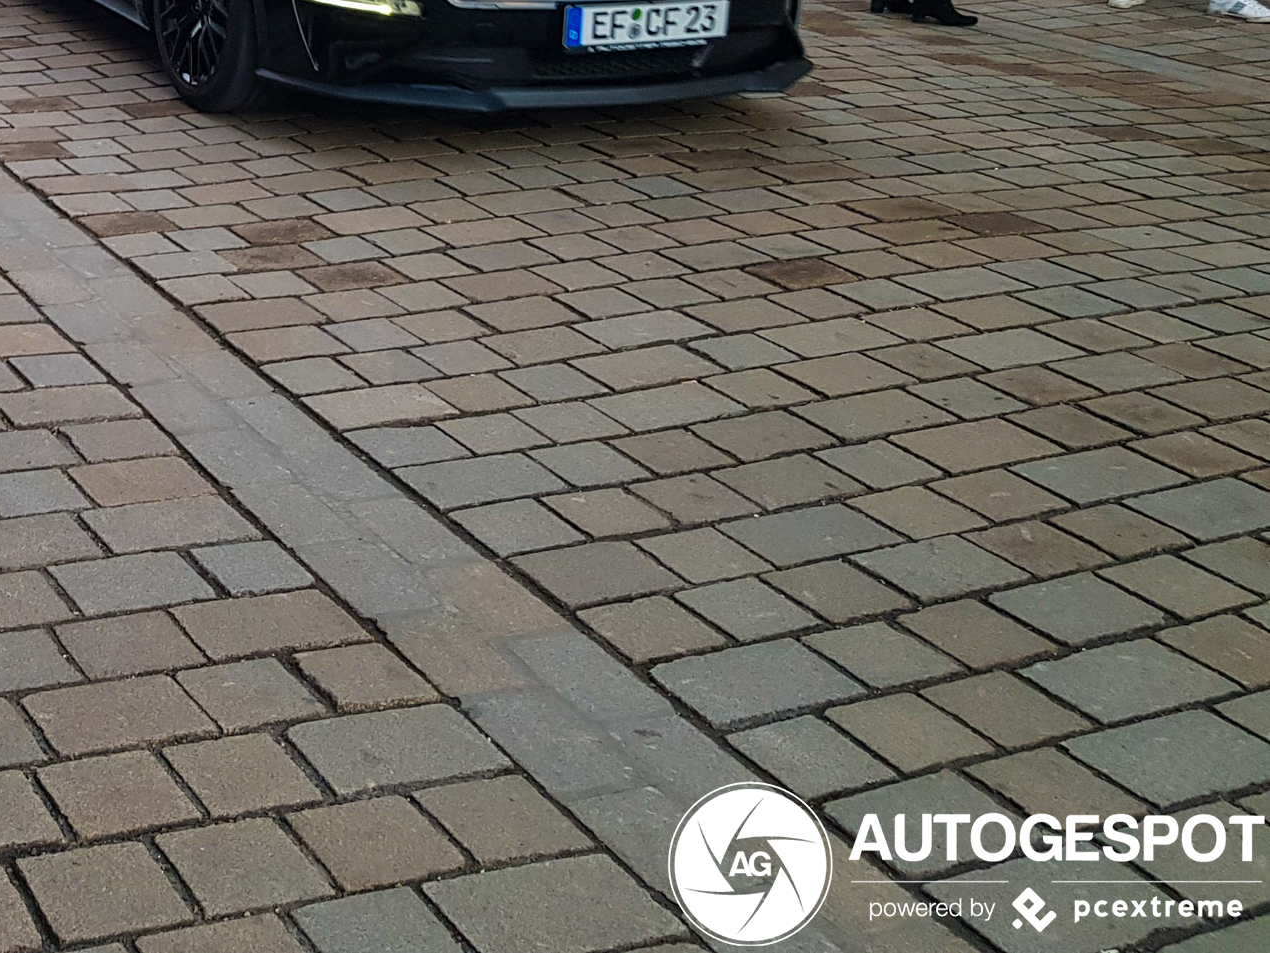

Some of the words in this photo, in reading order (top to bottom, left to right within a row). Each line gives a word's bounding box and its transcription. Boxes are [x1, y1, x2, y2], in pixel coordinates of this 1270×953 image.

[592, 11, 628, 39] EF
[646, 7, 681, 36] CF
[684, 4, 717, 33] 23
